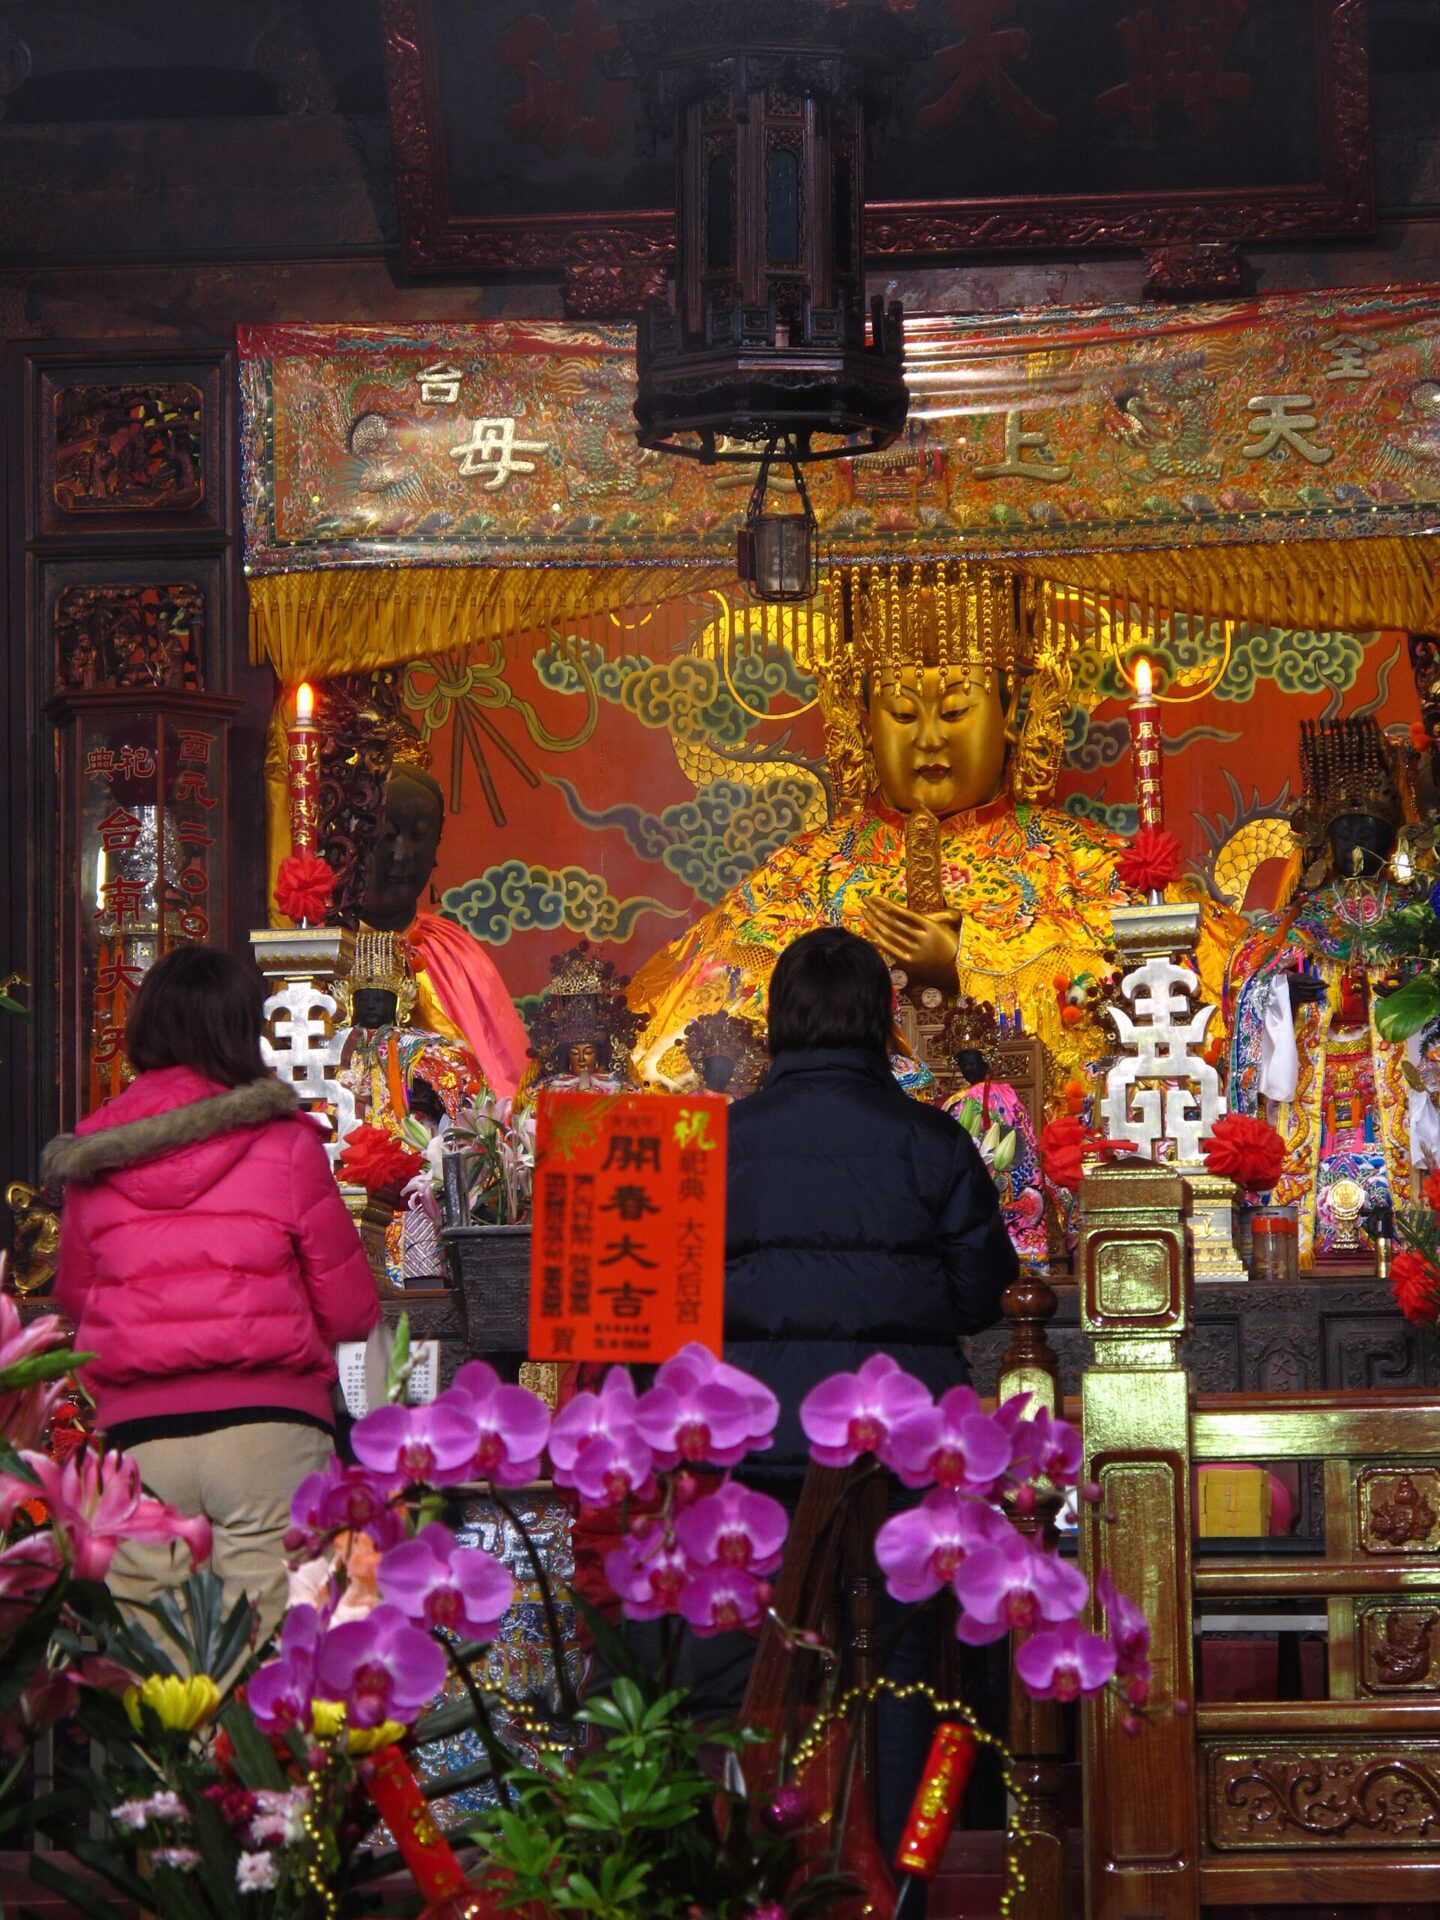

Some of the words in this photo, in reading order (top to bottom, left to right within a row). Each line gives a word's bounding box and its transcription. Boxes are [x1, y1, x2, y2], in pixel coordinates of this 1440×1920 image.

[416, 361, 463, 403] 台
[1320, 333, 1379, 380] 全
[289, 743, 313, 847] 國泰民安
[1136, 721, 1163, 825] 風調雨順
[674, 1109, 717, 1150] 祝
[595, 1135, 662, 1319] 開春大吉
